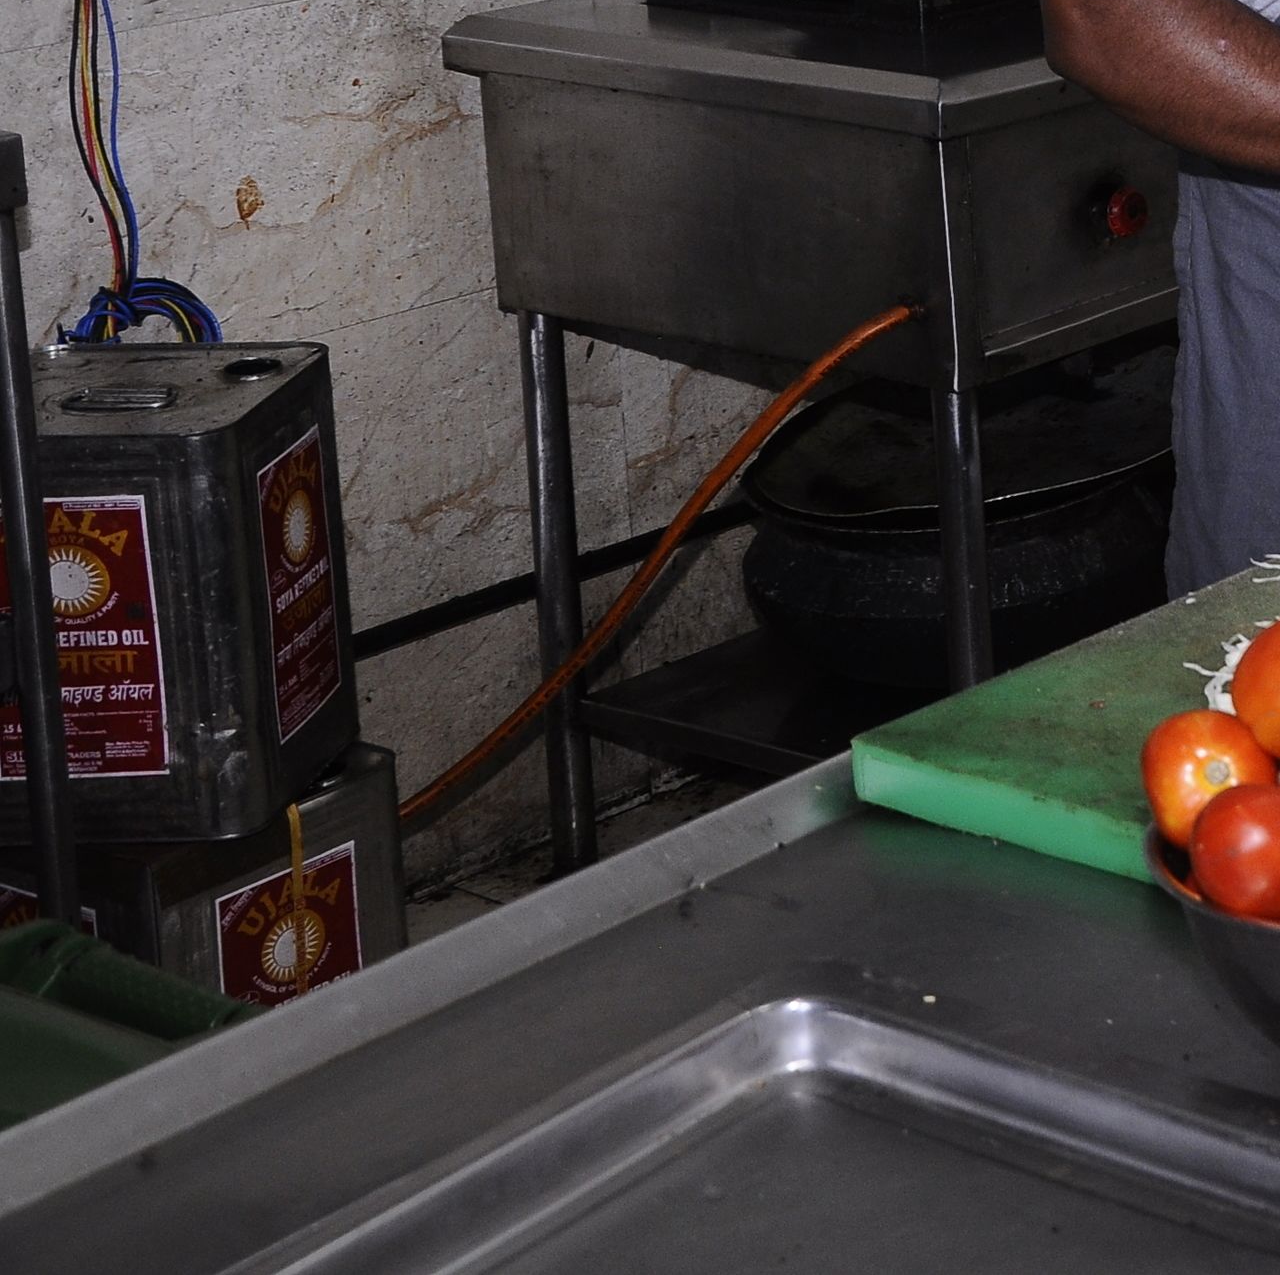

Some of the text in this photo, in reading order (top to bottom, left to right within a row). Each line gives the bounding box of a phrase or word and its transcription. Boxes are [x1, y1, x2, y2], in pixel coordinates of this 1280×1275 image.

[64, 613, 97, 625] QUALITY
[56, 629, 149, 648] EFINED OIL
